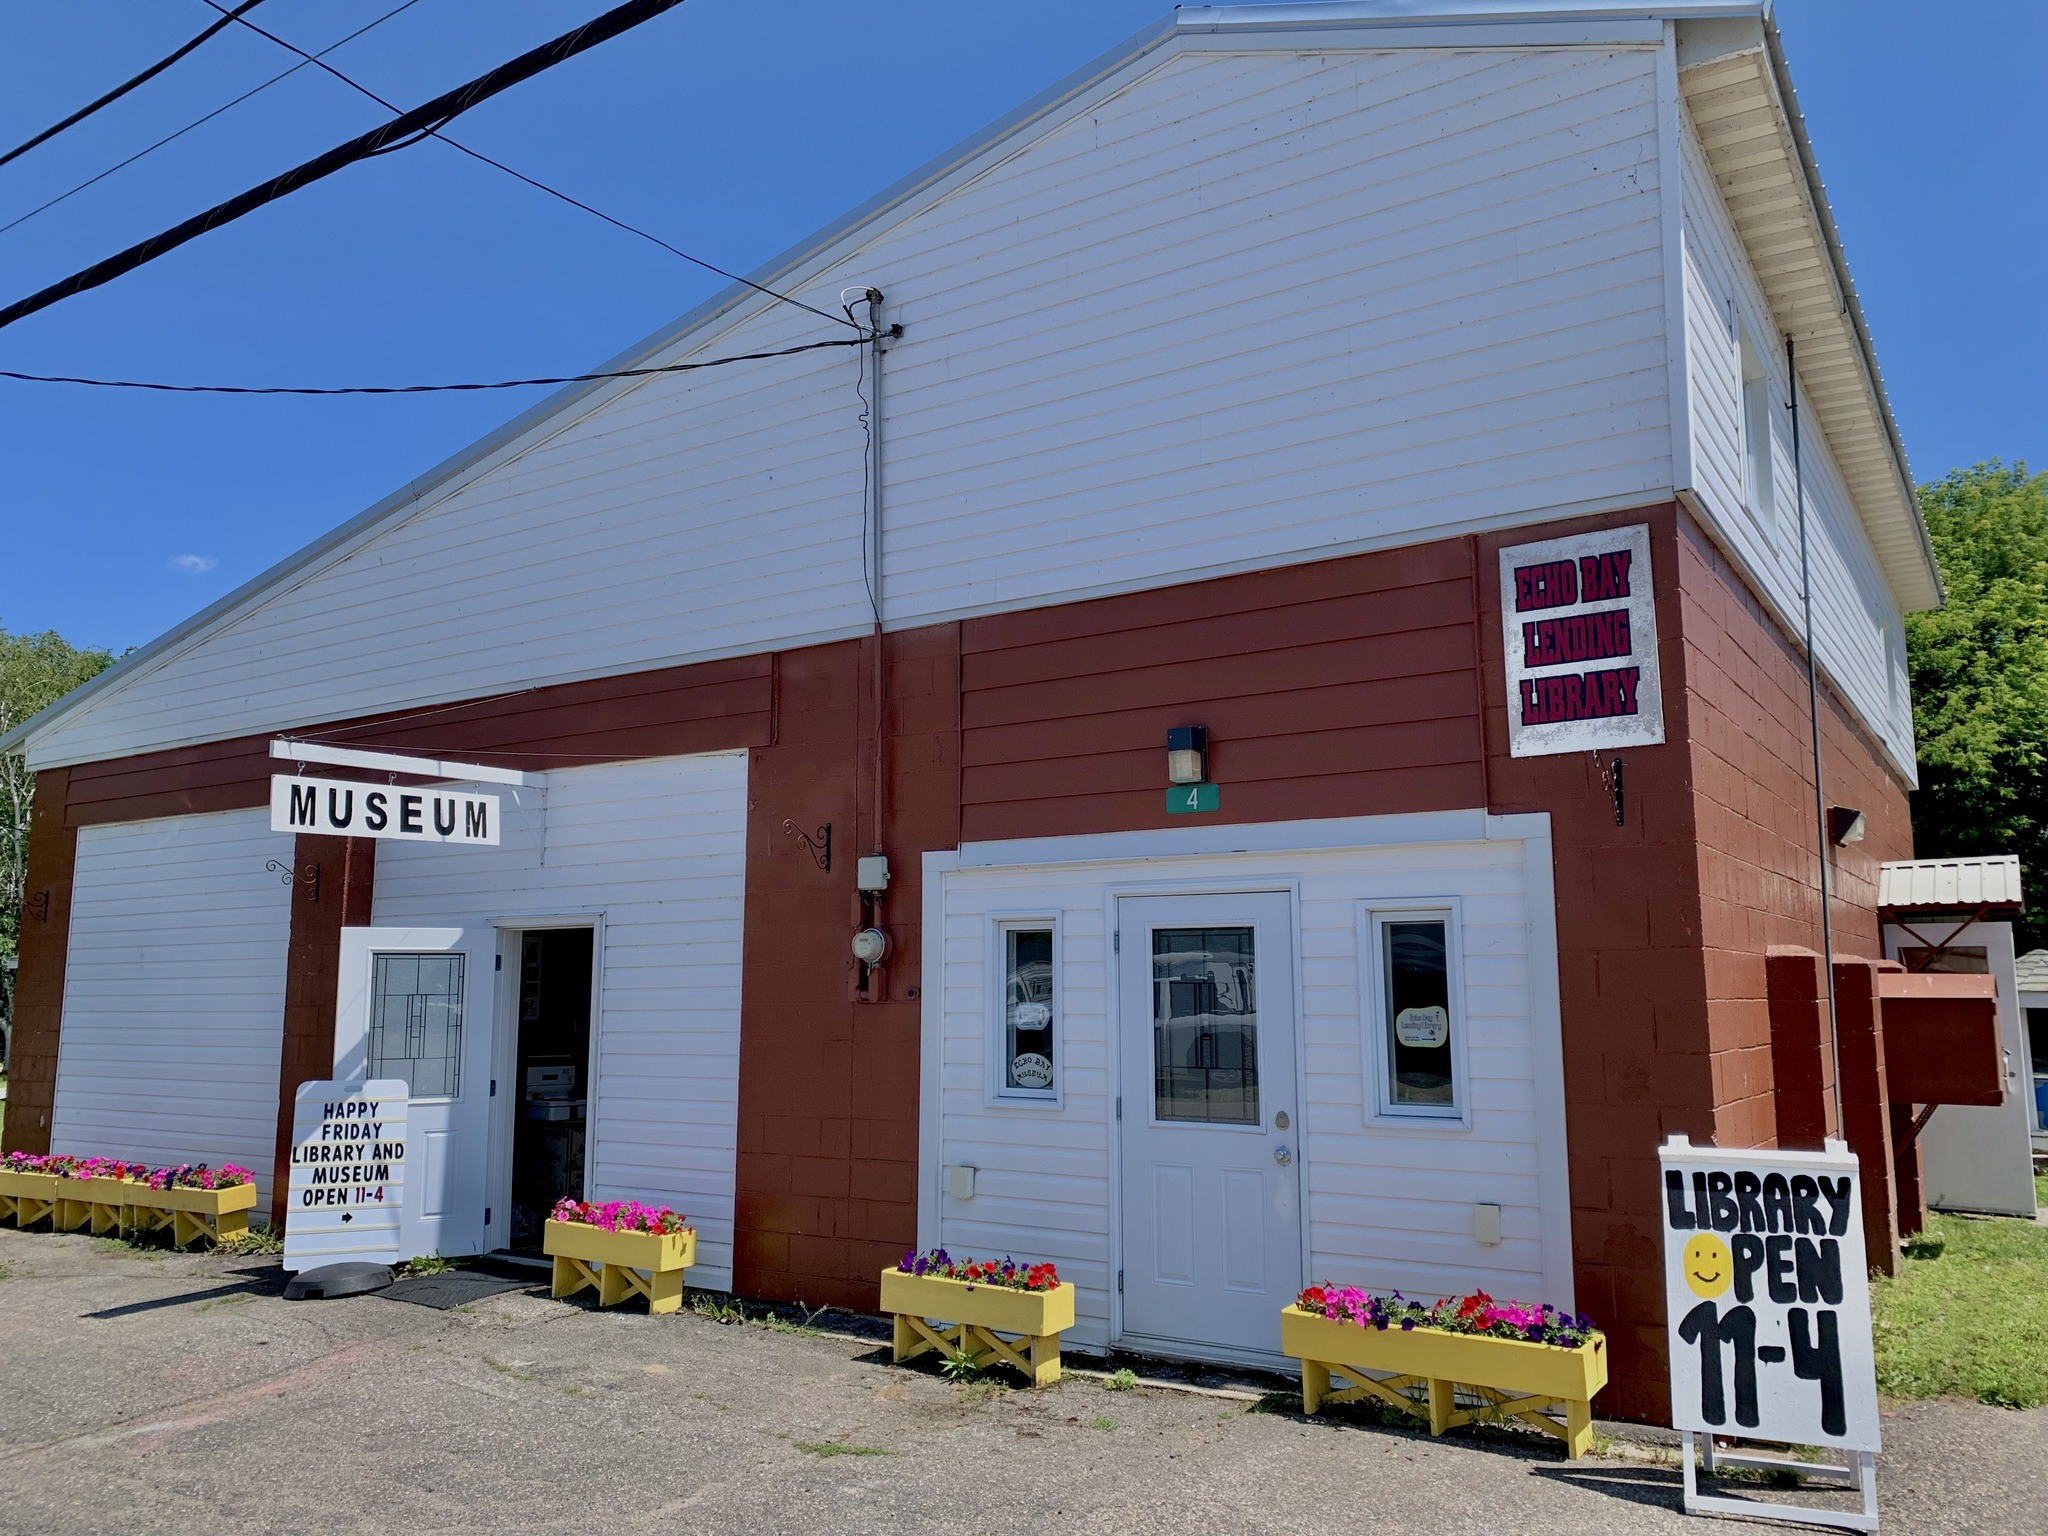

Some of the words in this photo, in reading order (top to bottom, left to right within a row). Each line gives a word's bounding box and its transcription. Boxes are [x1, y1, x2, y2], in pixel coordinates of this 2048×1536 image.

[1514, 559, 1578, 613] ECHO
[1579, 549, 1632, 603] BAY
[1522, 608, 1632, 668] LENDING
[1519, 666, 1640, 726] LIBRARY
[1186, 788, 1198, 810] 4
[290, 784, 487, 838] MUSEUM
[1014, 1057, 1032, 1069] ECHO
[1034, 1057, 1051, 1071] BAY
[1017, 1069, 1048, 1082] MUSEUM
[324, 1102, 379, 1120] HAPPY
[322, 1122, 382, 1141] FRIDAY
[292, 1144, 365, 1163] LIBRARY
[372, 1142, 404, 1161] AND
[312, 1164, 389, 1184] MUSEUM
[303, 1187, 347, 1207] OPEN
[355, 1186, 384, 1204] 11-4
[1665, 1170, 1851, 1237] LIBRARY
[1678, 1300, 1847, 1437] 11-4
